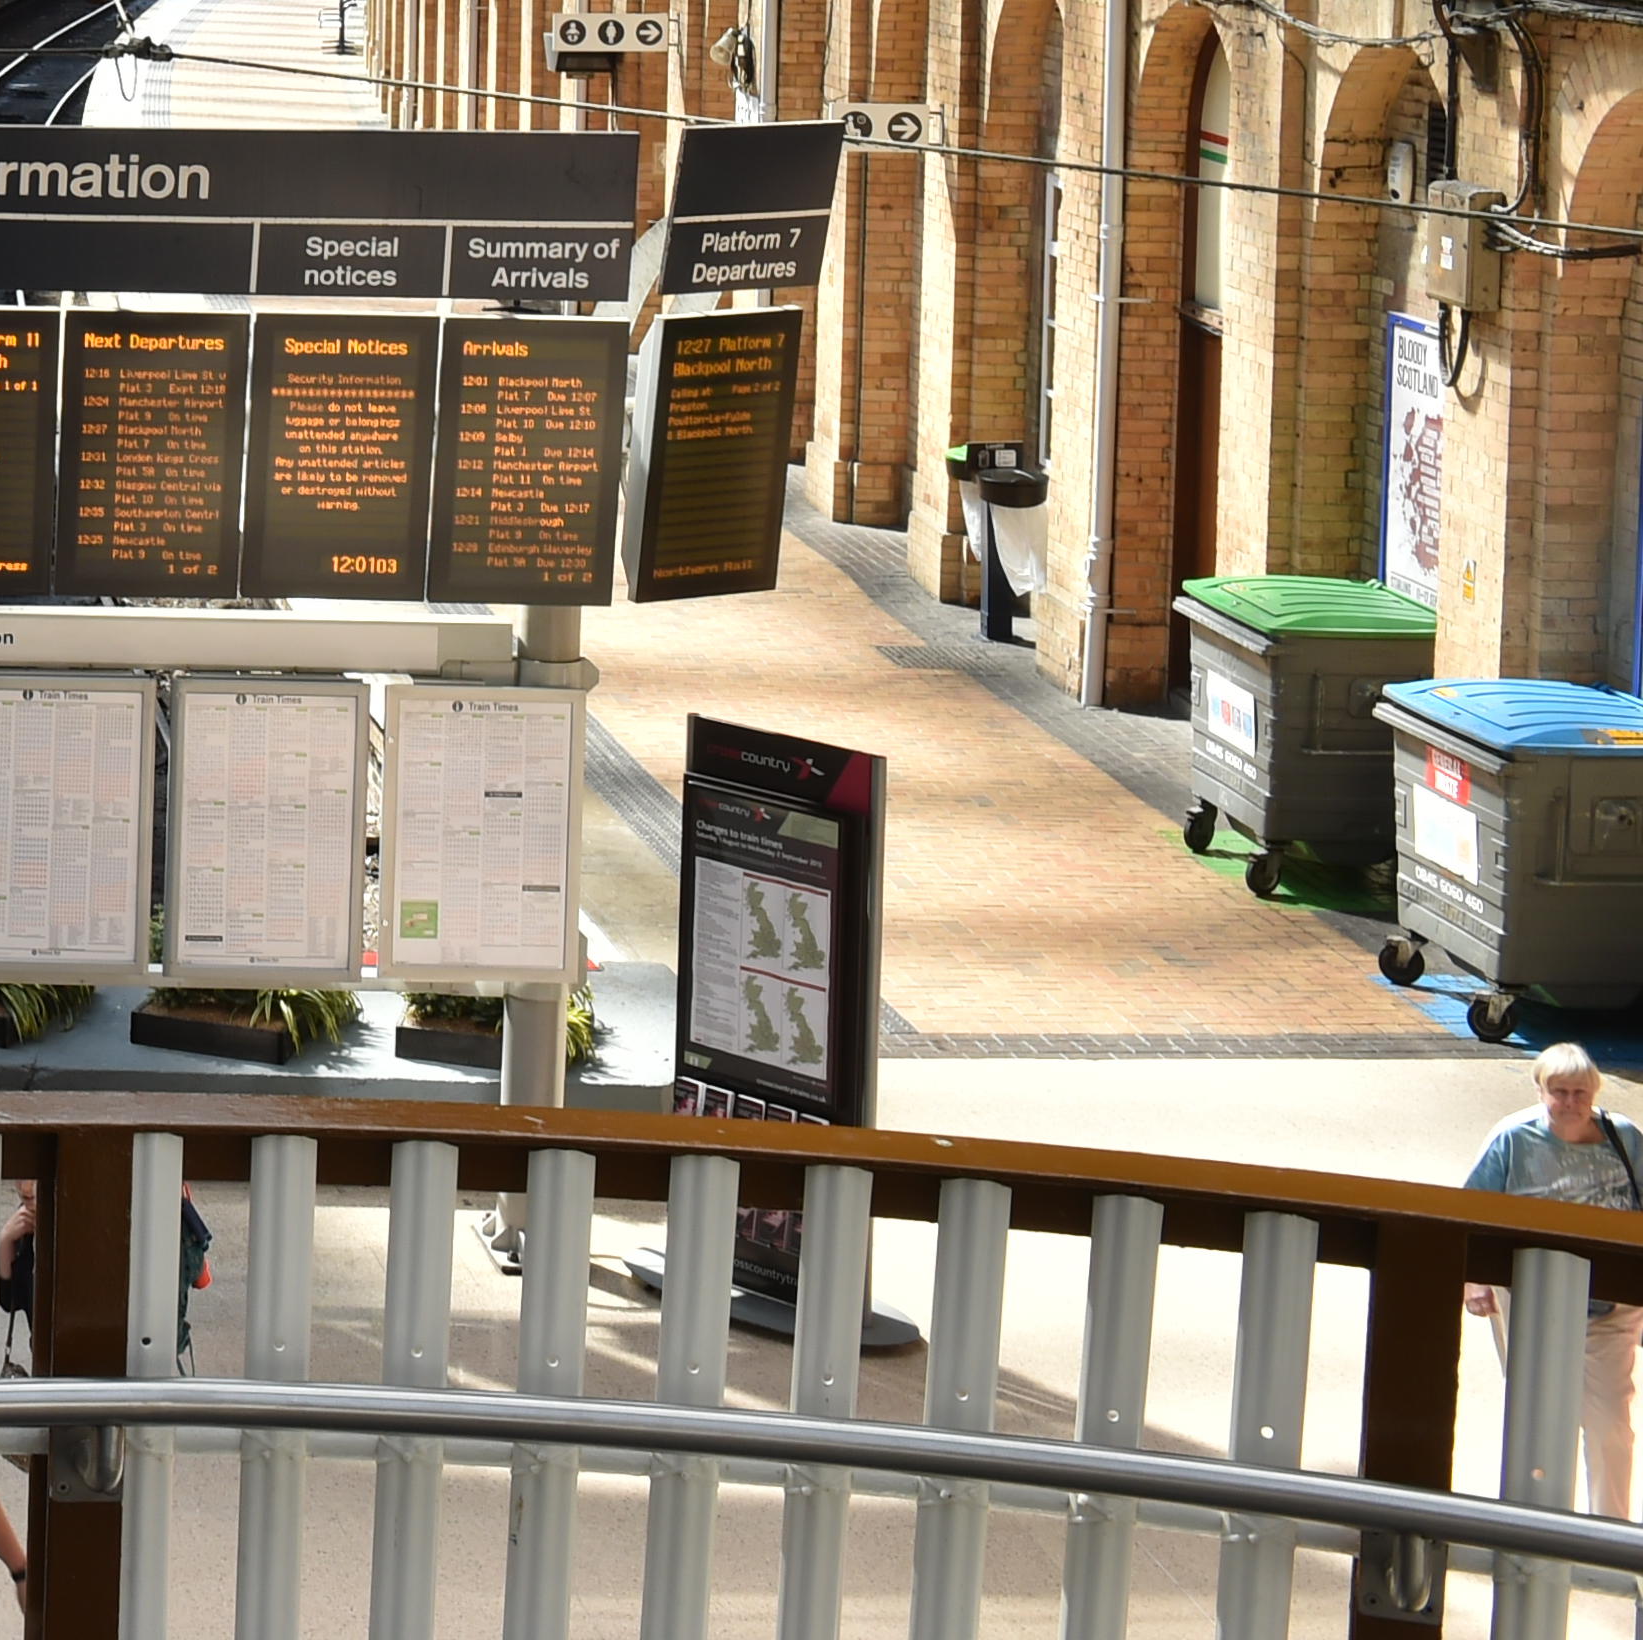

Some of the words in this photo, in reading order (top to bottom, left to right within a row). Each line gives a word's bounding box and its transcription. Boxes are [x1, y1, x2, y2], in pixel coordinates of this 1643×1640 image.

[306, 236, 399, 260] Special
[701, 230, 781, 253] Platform
[787, 228, 802, 248] 7
[468, 238, 587, 263] Summary
[593, 238, 621, 259] of
[303, 265, 397, 287] notices
[491, 267, 589, 288] Arrivals
[691, 259, 797, 285] Departures
[27, 332, 40, 347] 11
[84, 333, 122, 348] Next
[129, 334, 225, 351] Departures
[284, 338, 341, 355] Special
[348, 339, 408, 355] Notices
[720, 336, 771, 352] Platform
[463, 341, 529, 357] Arrivals
[1398, 336, 1427, 367] BLOODY
[736, 356, 772, 373] North
[287, 373, 333, 384] Security
[338, 374, 402, 385] Information
[1397, 363, 1438, 399] SCOTLAND
[328, 402, 340, 413] do
[345, 402, 363, 413] not
[285, 430, 345, 440] unattended
[40, 690, 60, 700] Train
[64, 690, 89, 701] Times
[253, 694, 274, 704] Train
[277, 695, 302, 705] Times
[469, 702, 490, 712] Train
[493, 703, 519, 713] Times
